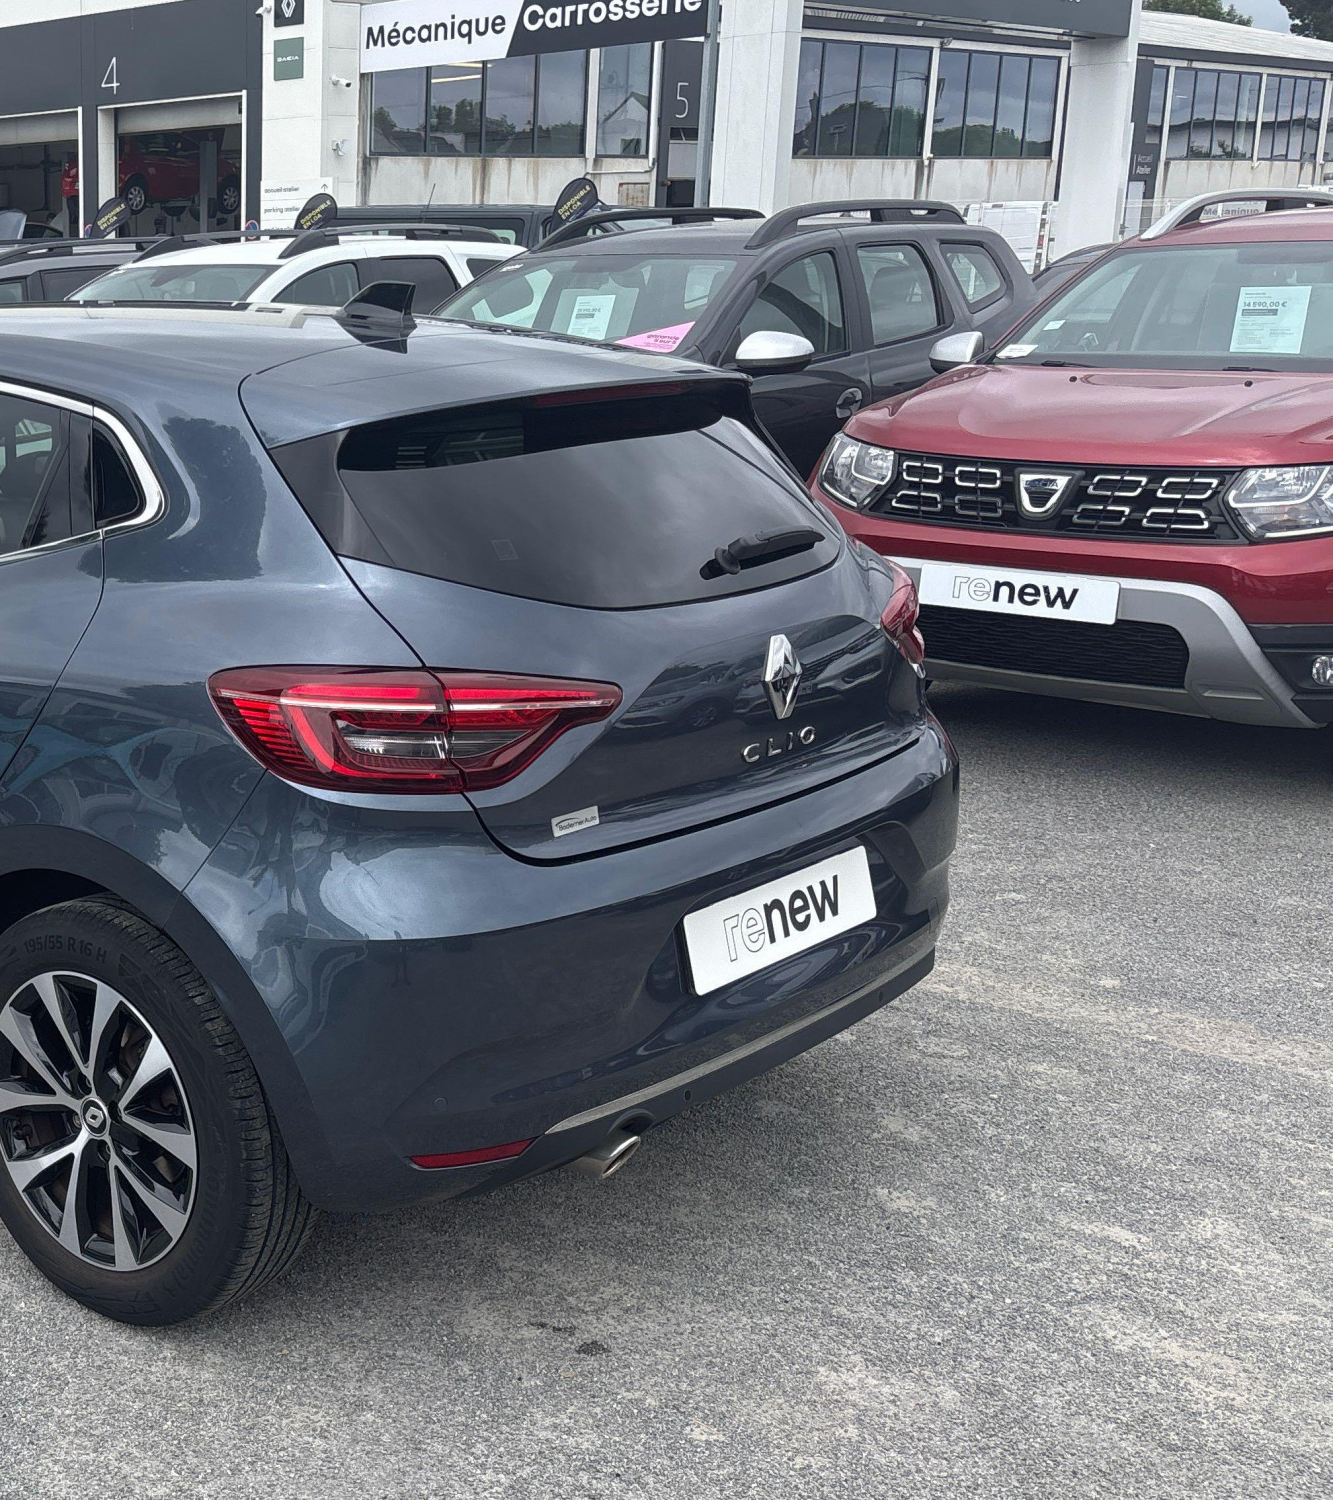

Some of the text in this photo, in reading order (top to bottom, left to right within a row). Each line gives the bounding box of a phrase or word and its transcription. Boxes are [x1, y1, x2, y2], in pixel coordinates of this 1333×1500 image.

[365, 14, 507, 50] Mécanique
[101, 56, 121, 95] 4
[675, 82, 689, 118] 5
[558, 184, 592, 216] DISPONIBLE
[561, 210, 571, 220] EN
[569, 201, 582, 213] LOA
[1252, 301, 1280, 309] 590,00
[952, 575, 1079, 610] renew
[742, 726, 816, 763] CLIO
[723, 874, 839, 963] renew
[24, 934, 63, 954] 195/55
